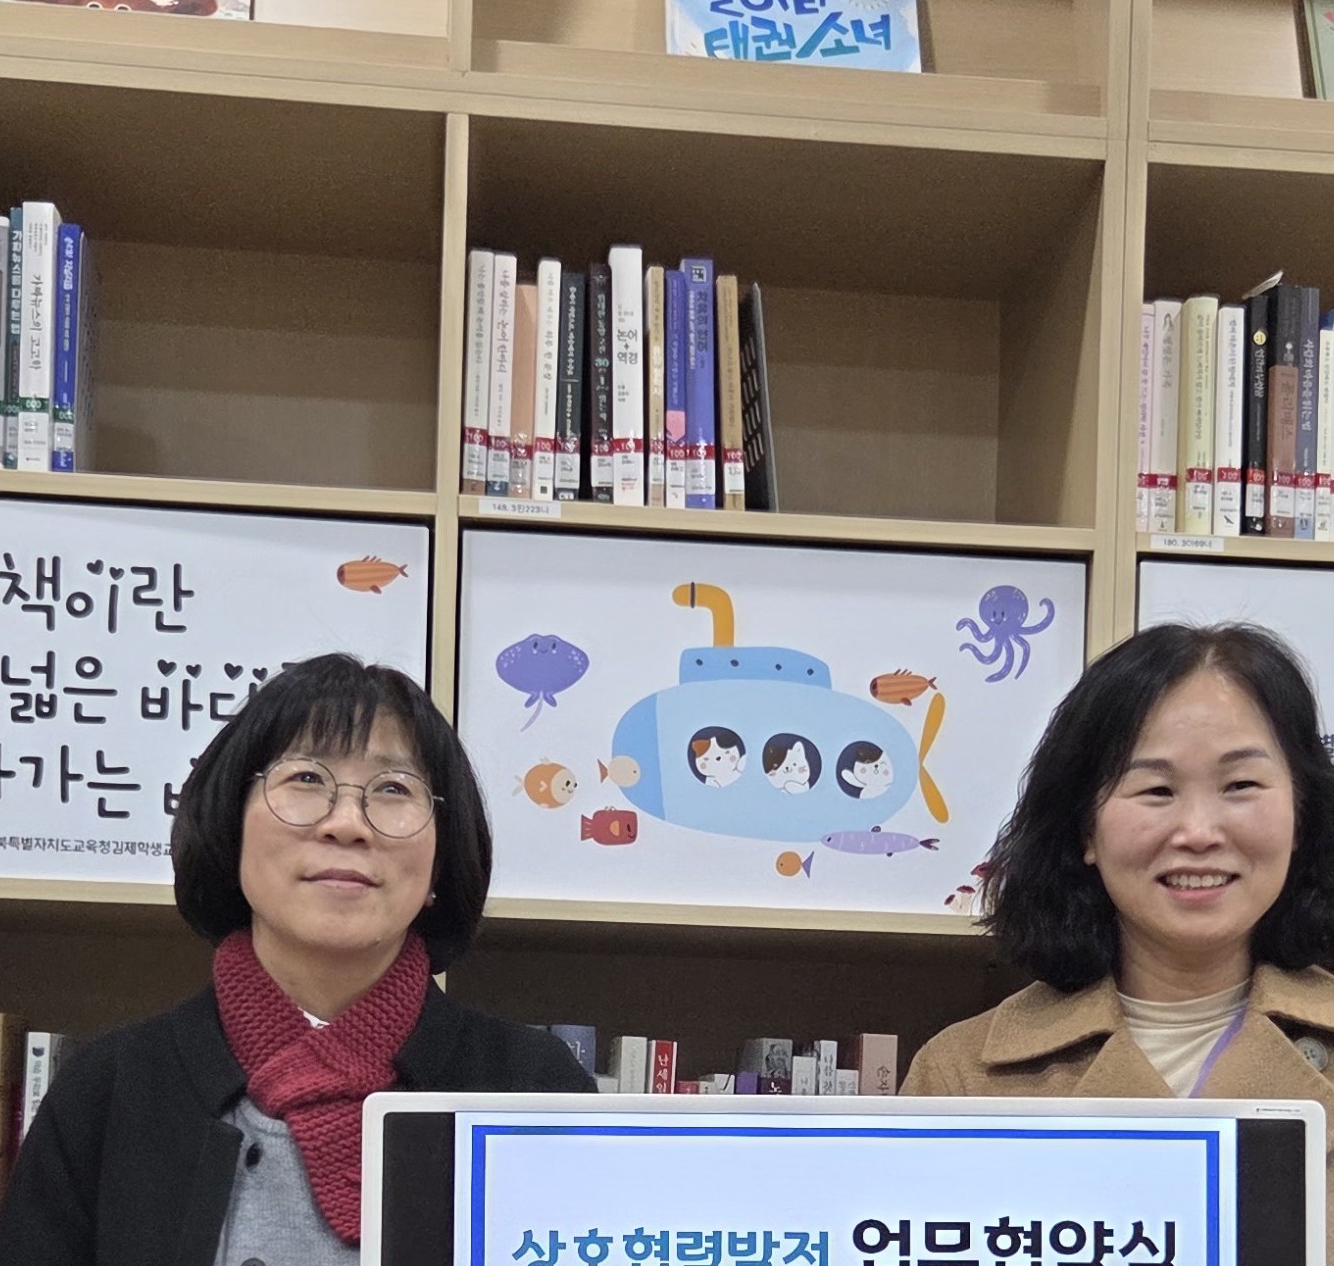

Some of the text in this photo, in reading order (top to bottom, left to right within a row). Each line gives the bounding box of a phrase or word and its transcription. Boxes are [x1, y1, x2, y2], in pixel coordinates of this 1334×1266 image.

[617, 329, 638, 342] 논어
[1, 650, 117, 724] 넓은
[141, 658, 295, 730] 바다
